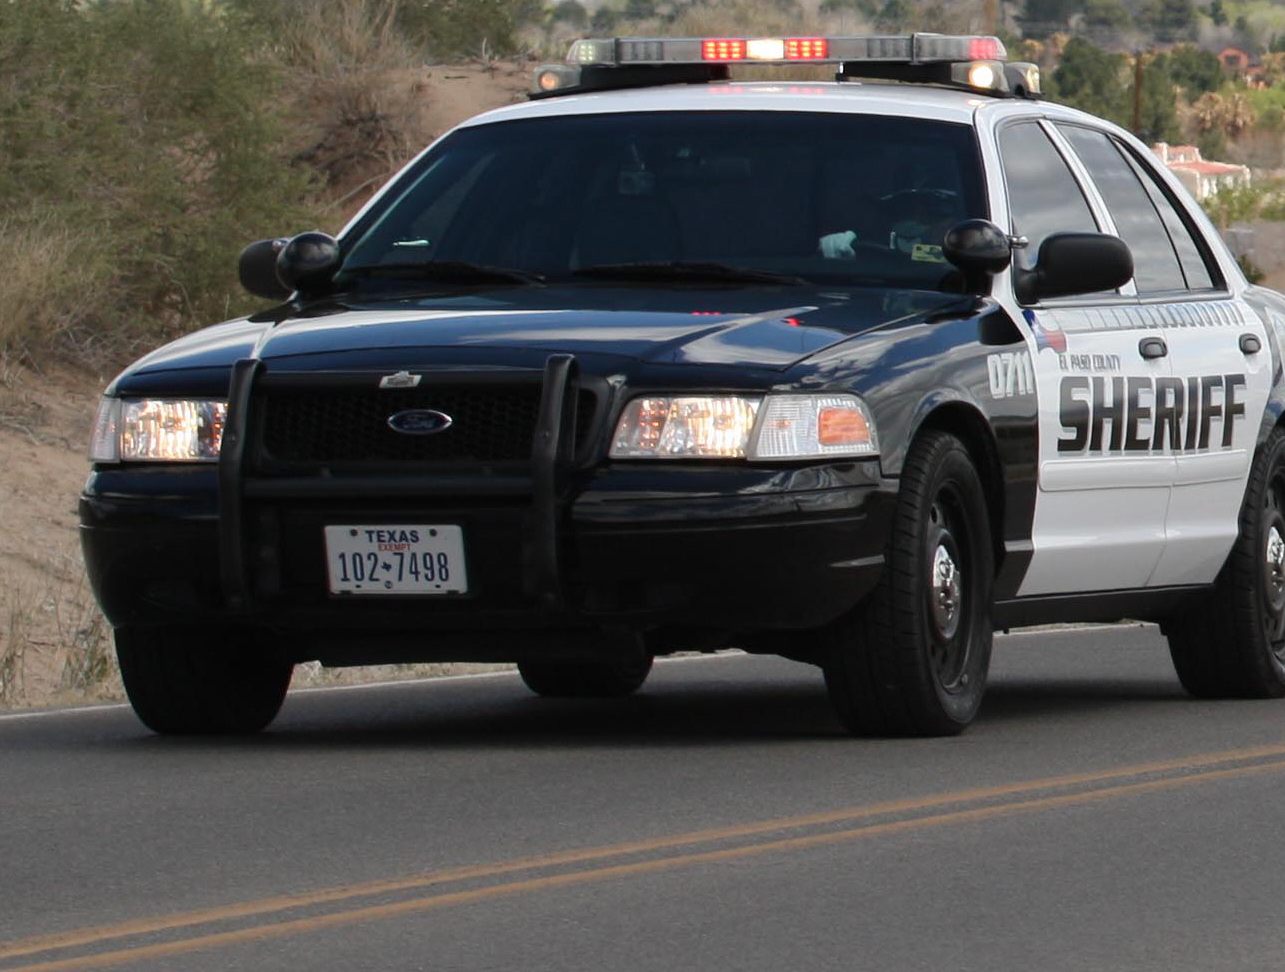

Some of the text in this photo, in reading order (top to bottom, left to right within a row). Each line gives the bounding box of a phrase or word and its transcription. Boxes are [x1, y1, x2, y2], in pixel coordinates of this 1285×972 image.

[1071, 354, 1091, 370] PASO
[1093, 355, 1121, 371] COUNTY
[1057, 373, 1247, 453] SHERIFF
[365, 530, 420, 543] TEXAS
[377, 543, 411, 552] EXEMPT
